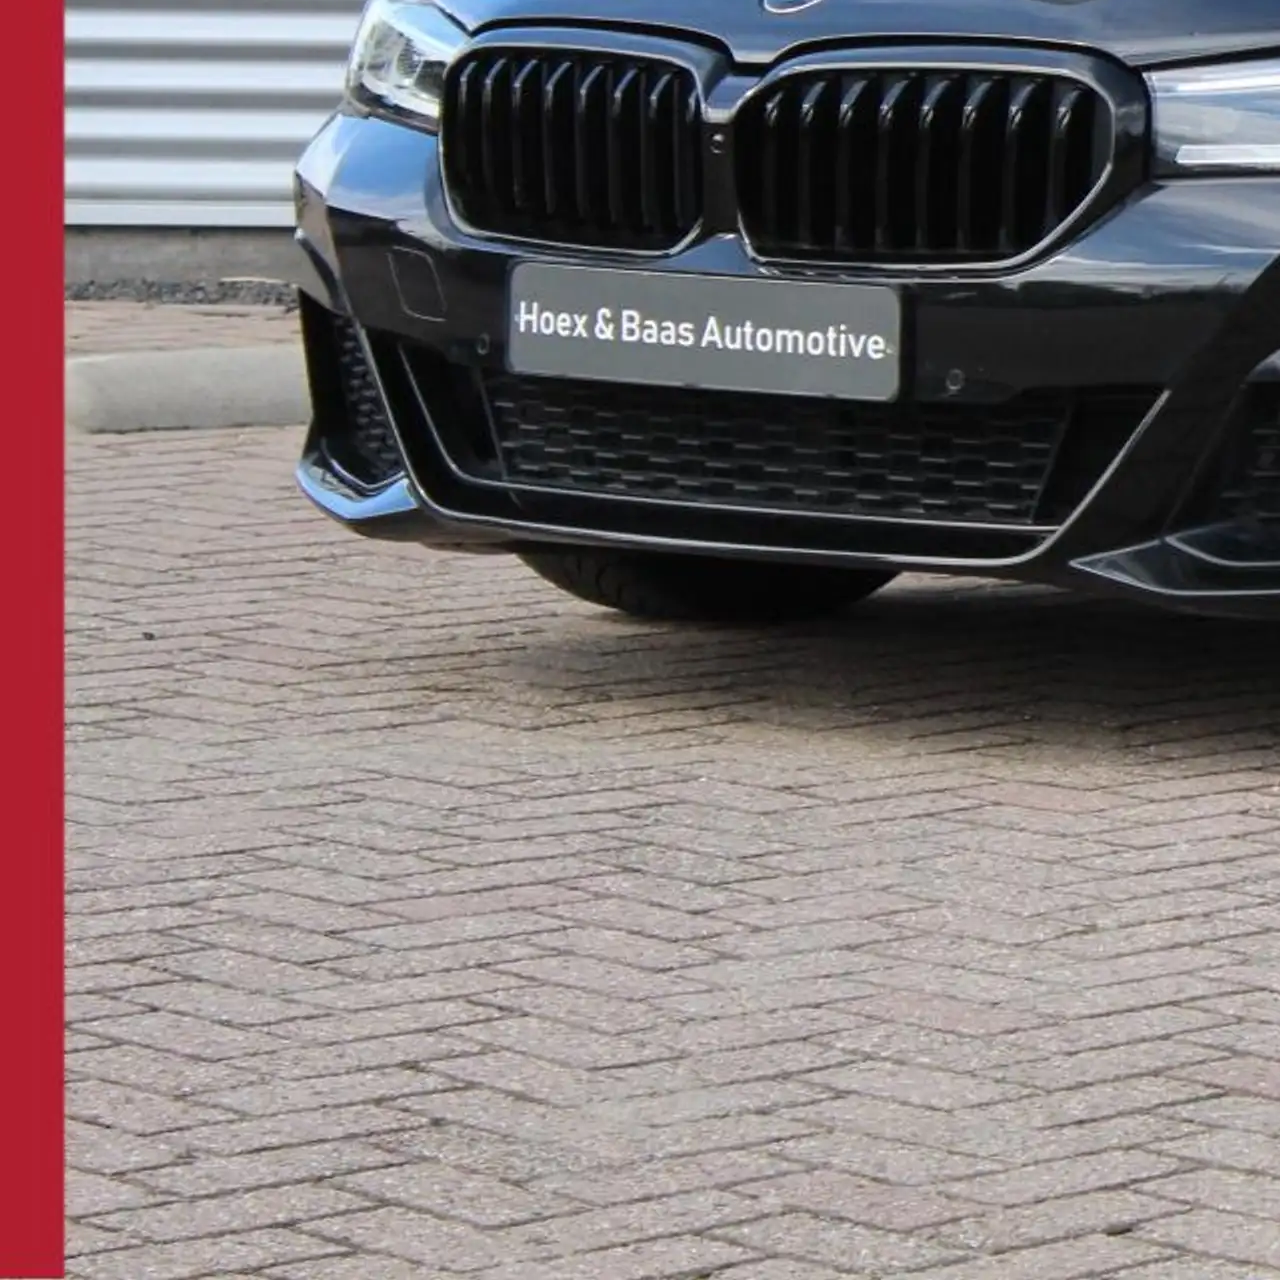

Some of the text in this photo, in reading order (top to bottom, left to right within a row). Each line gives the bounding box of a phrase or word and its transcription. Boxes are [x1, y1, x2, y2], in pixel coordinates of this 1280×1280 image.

[518, 301, 886, 360] Hoex & Baas Automotive
